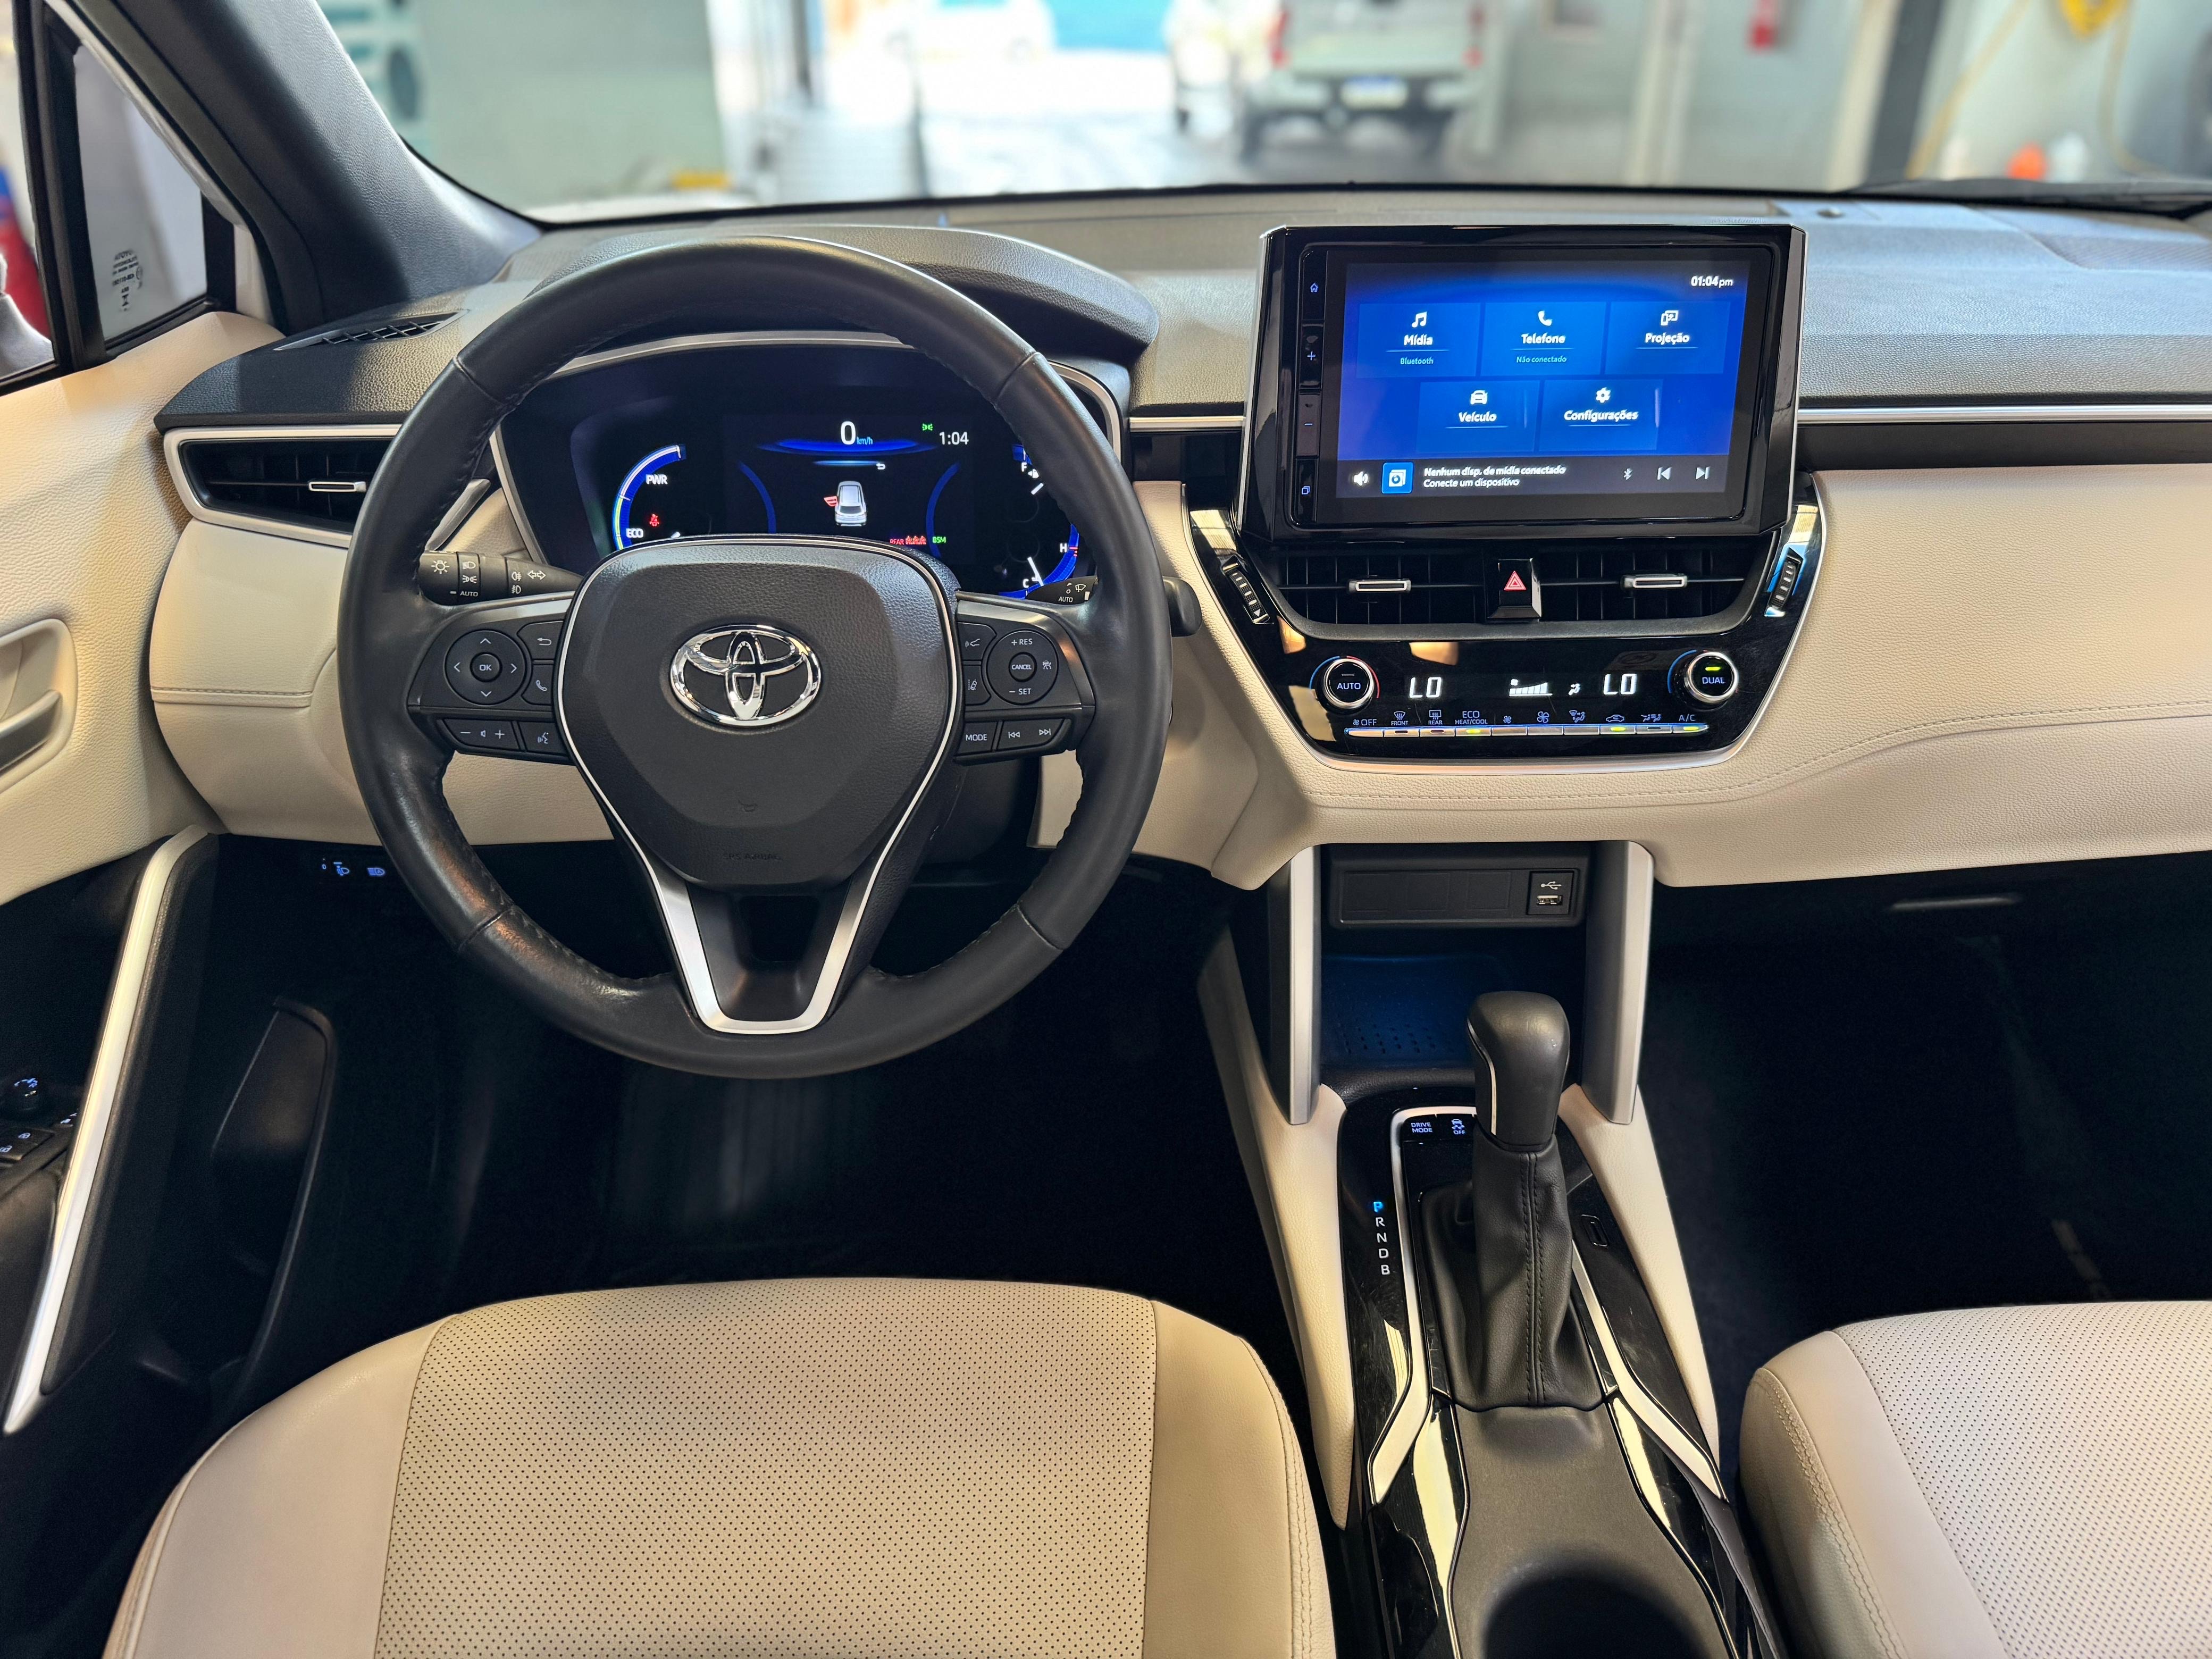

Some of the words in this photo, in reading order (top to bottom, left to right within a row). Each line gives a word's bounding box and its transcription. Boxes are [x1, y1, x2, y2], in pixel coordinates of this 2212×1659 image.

[1404, 334, 1433, 346] Mídia
[1521, 333, 1566, 344] Telefone
[1645, 333, 1690, 345] Projeção
[1459, 411, 1497, 423] Veículo
[1564, 410, 1639, 423] Configurações
[841, 421, 856, 445] 0
[857, 437, 873, 446] km/h
[939, 431, 969, 445] 1:04
[1021, 462, 1027, 472] F
[1424, 467, 1461, 476] Nenhum
[1462, 466, 1482, 477] disp.
[1483, 466, 1495, 476] de
[1496, 466, 1520, 475] mídia
[1520, 465, 1566, 475] conectado
[646, 474, 668, 484] PWR
[1423, 479, 1458, 488] Conecte
[1474, 478, 1520, 488] dispositivo
[626, 528, 643, 538] ECO
[1060, 543, 1067, 552] H
[1023, 579, 1029, 588] C
[1679, 714, 1696, 722] A/C
[966, 733, 987, 742] MODE
[1373, 1201, 1384, 1212] P
[1375, 1217, 1385, 1227] R
[1376, 1232, 1387, 1243] N
[1378, 1247, 1389, 1259] D
[1380, 1264, 1390, 1275] B
